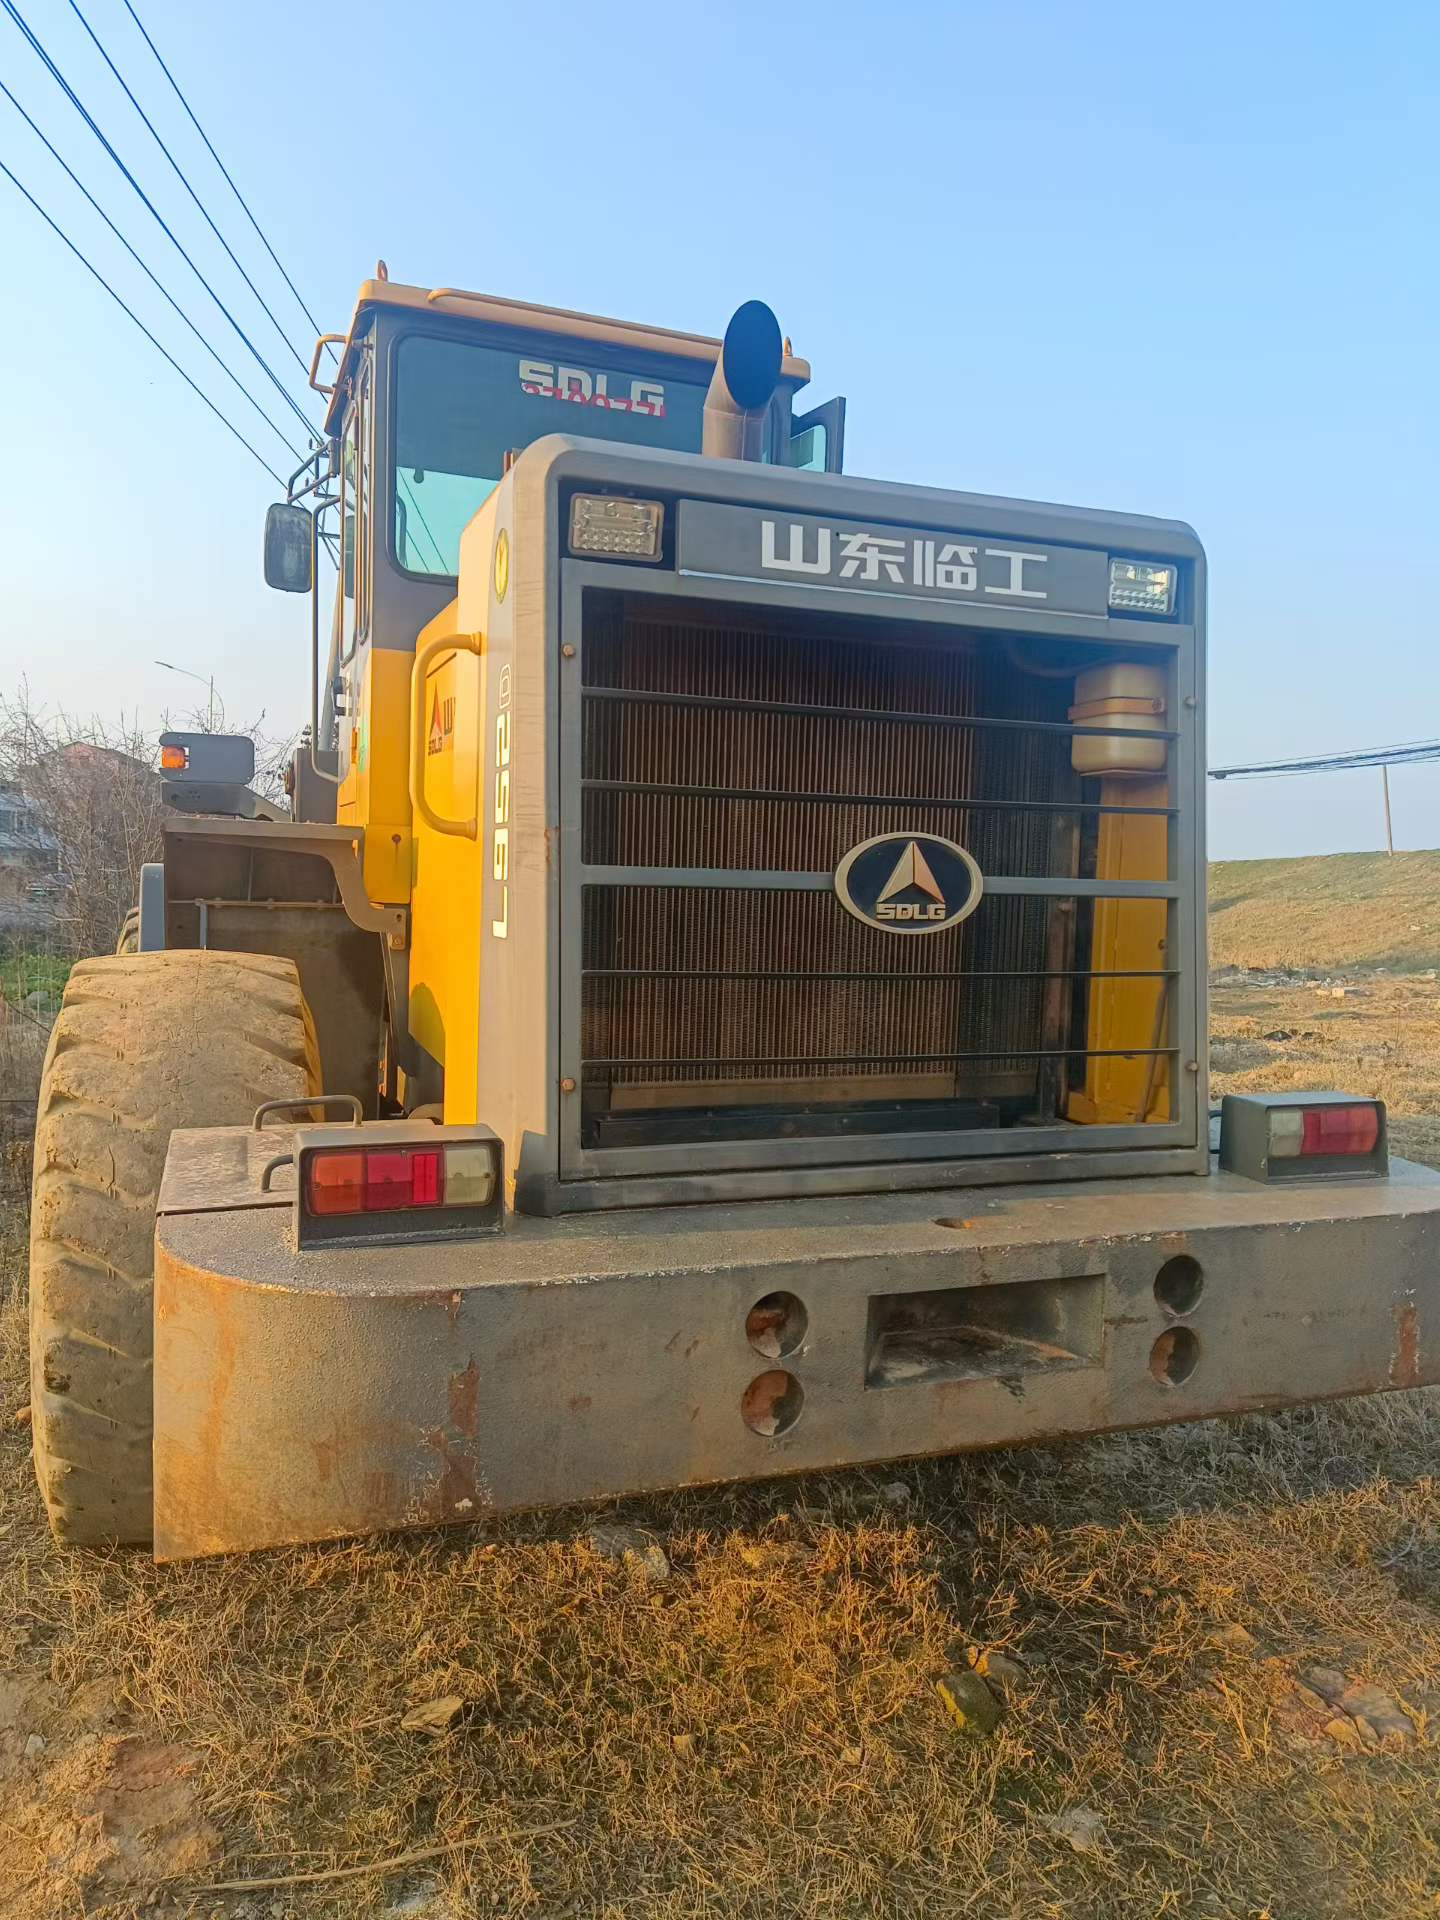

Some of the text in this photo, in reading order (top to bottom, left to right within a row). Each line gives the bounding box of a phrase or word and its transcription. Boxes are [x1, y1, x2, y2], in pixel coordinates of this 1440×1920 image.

[519, 359, 666, 417] SDLG
[761, 520, 1048, 599] 山东临工
[876, 903, 946, 920] SDLG
